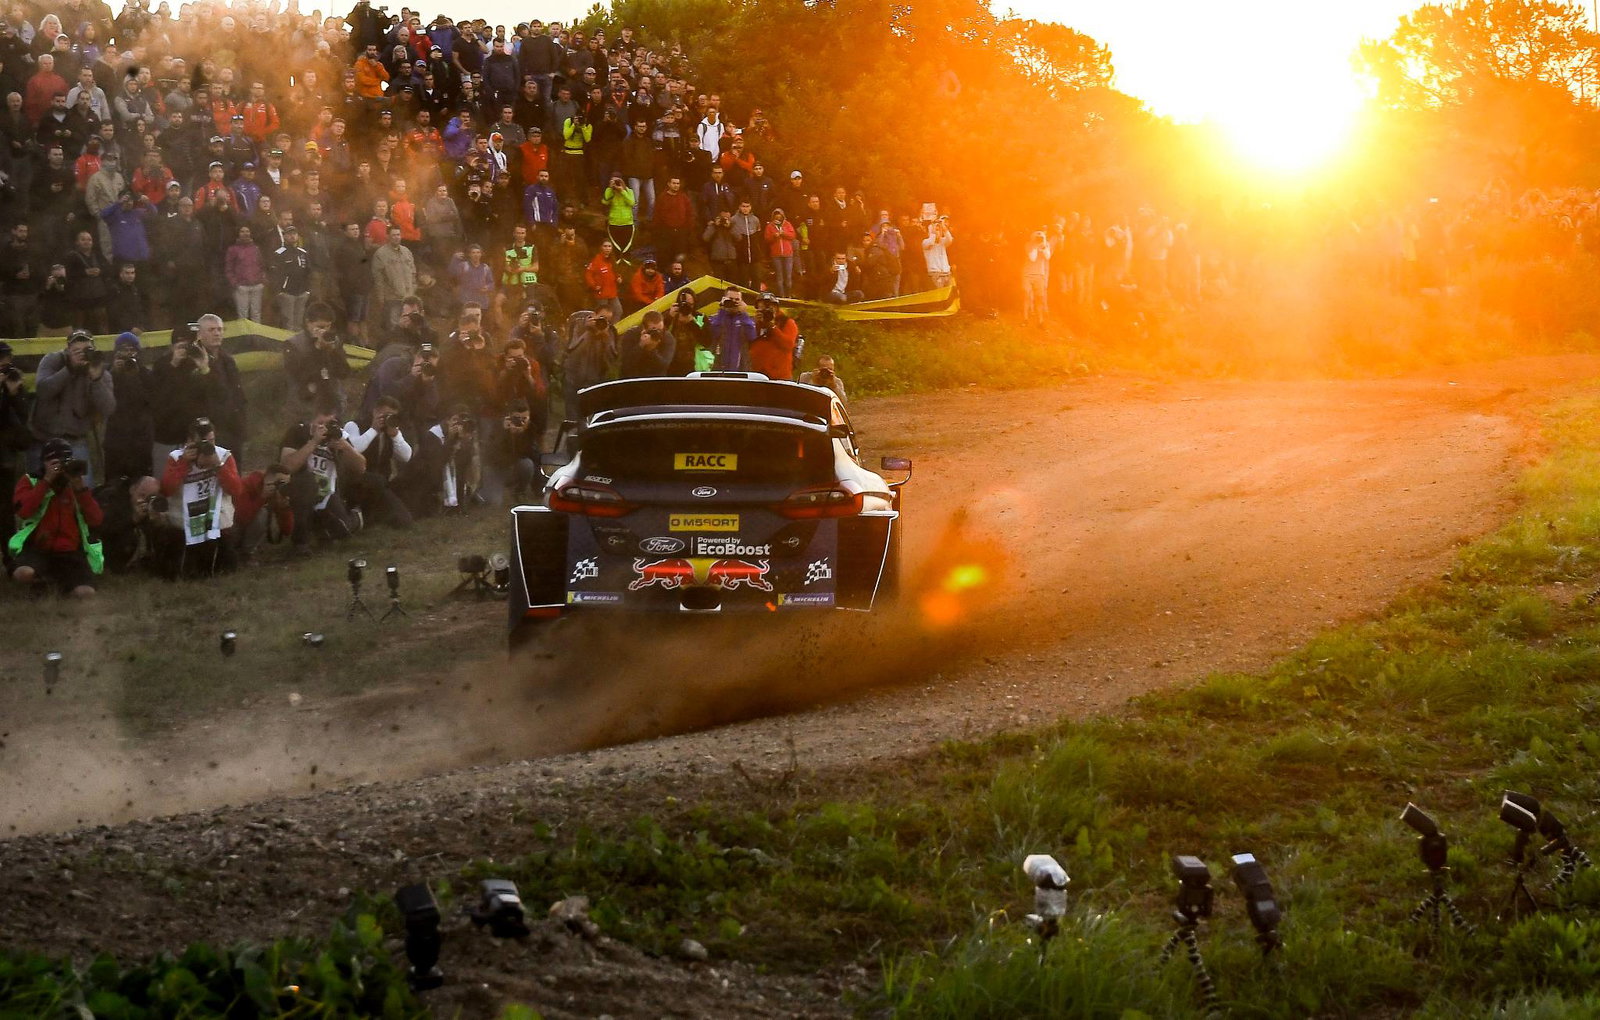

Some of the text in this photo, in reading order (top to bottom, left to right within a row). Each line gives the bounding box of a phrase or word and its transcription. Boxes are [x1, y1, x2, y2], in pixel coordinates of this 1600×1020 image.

[685, 455, 726, 467] RACC
[646, 538, 678, 552] Ford
[732, 537, 742, 545] by
[697, 543, 770, 555] EcoBoost
